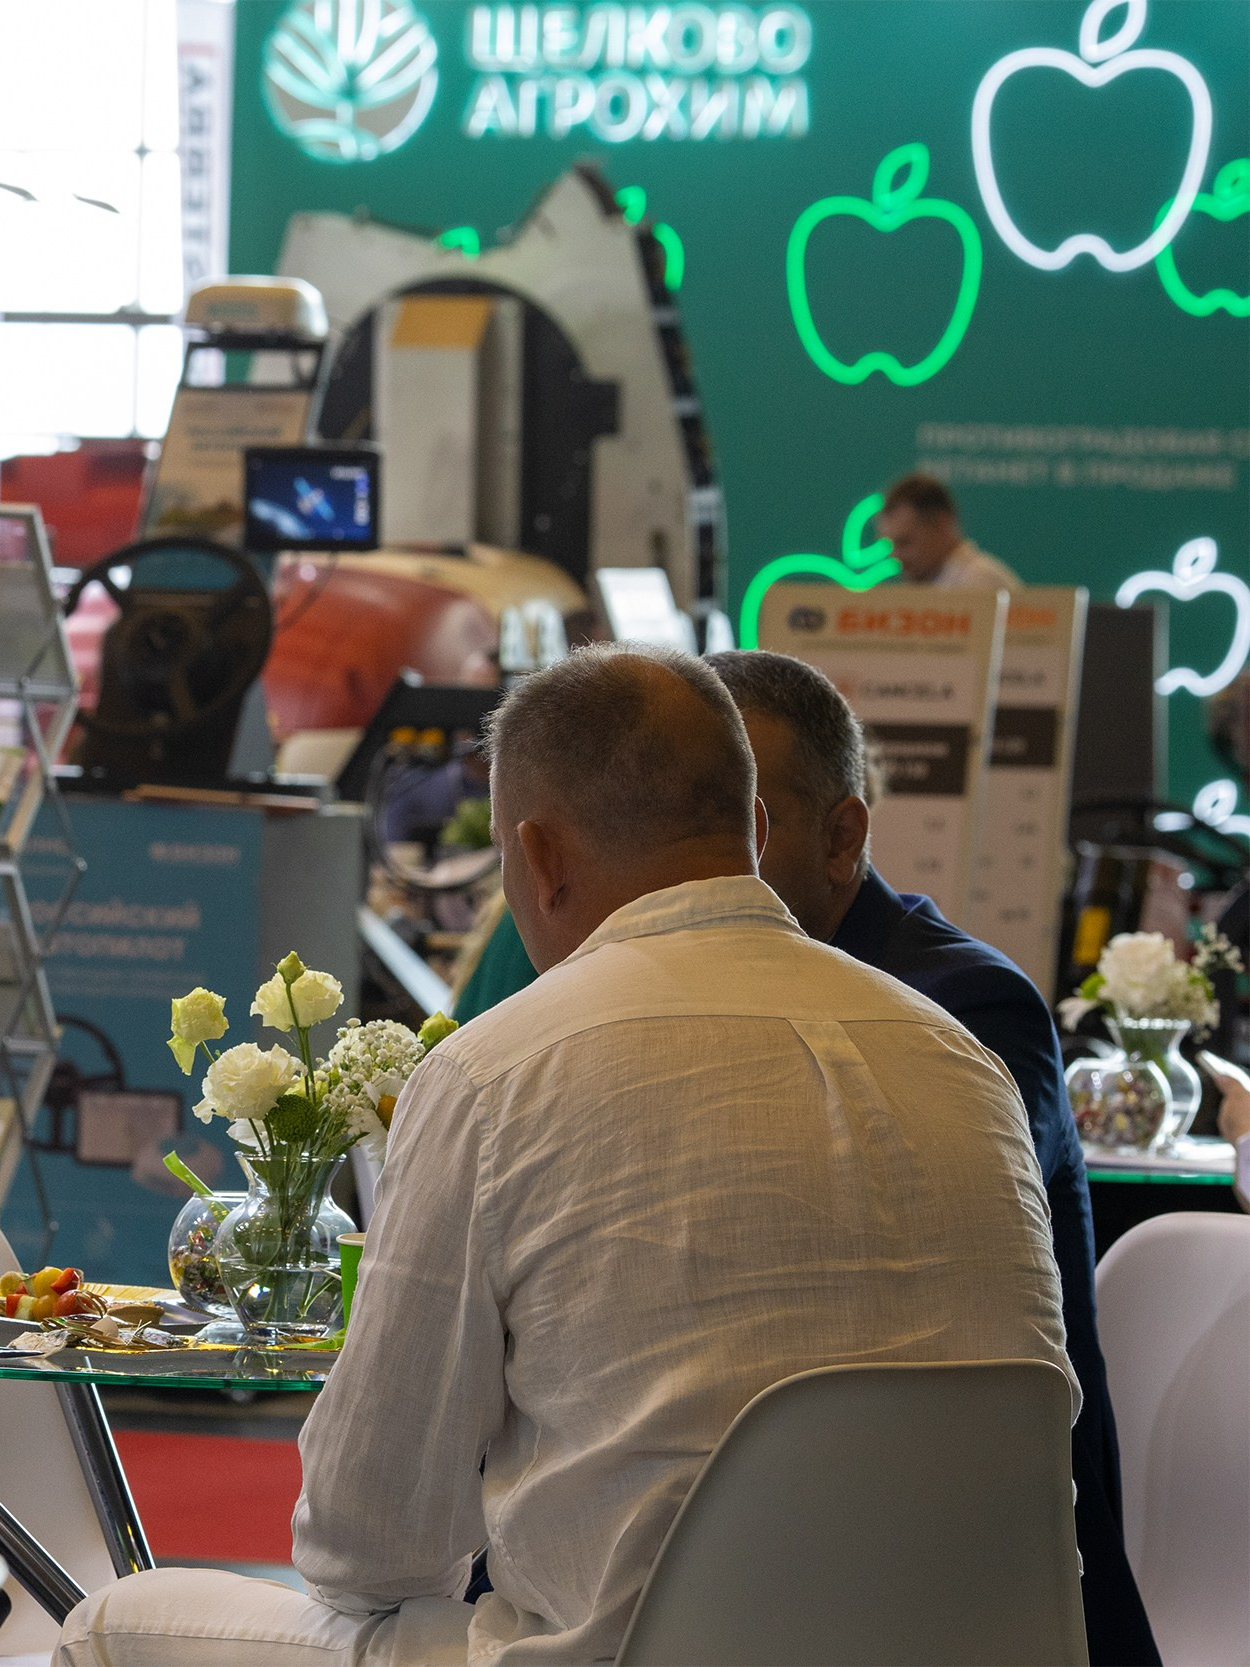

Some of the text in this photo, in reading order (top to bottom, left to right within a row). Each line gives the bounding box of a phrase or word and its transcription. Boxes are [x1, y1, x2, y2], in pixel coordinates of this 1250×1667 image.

[466, 71, 811, 142] АГРОХИМ
[836, 606, 972, 637] БИЗОН
[26, 896, 202, 930] ОССИЙСКИЙ
